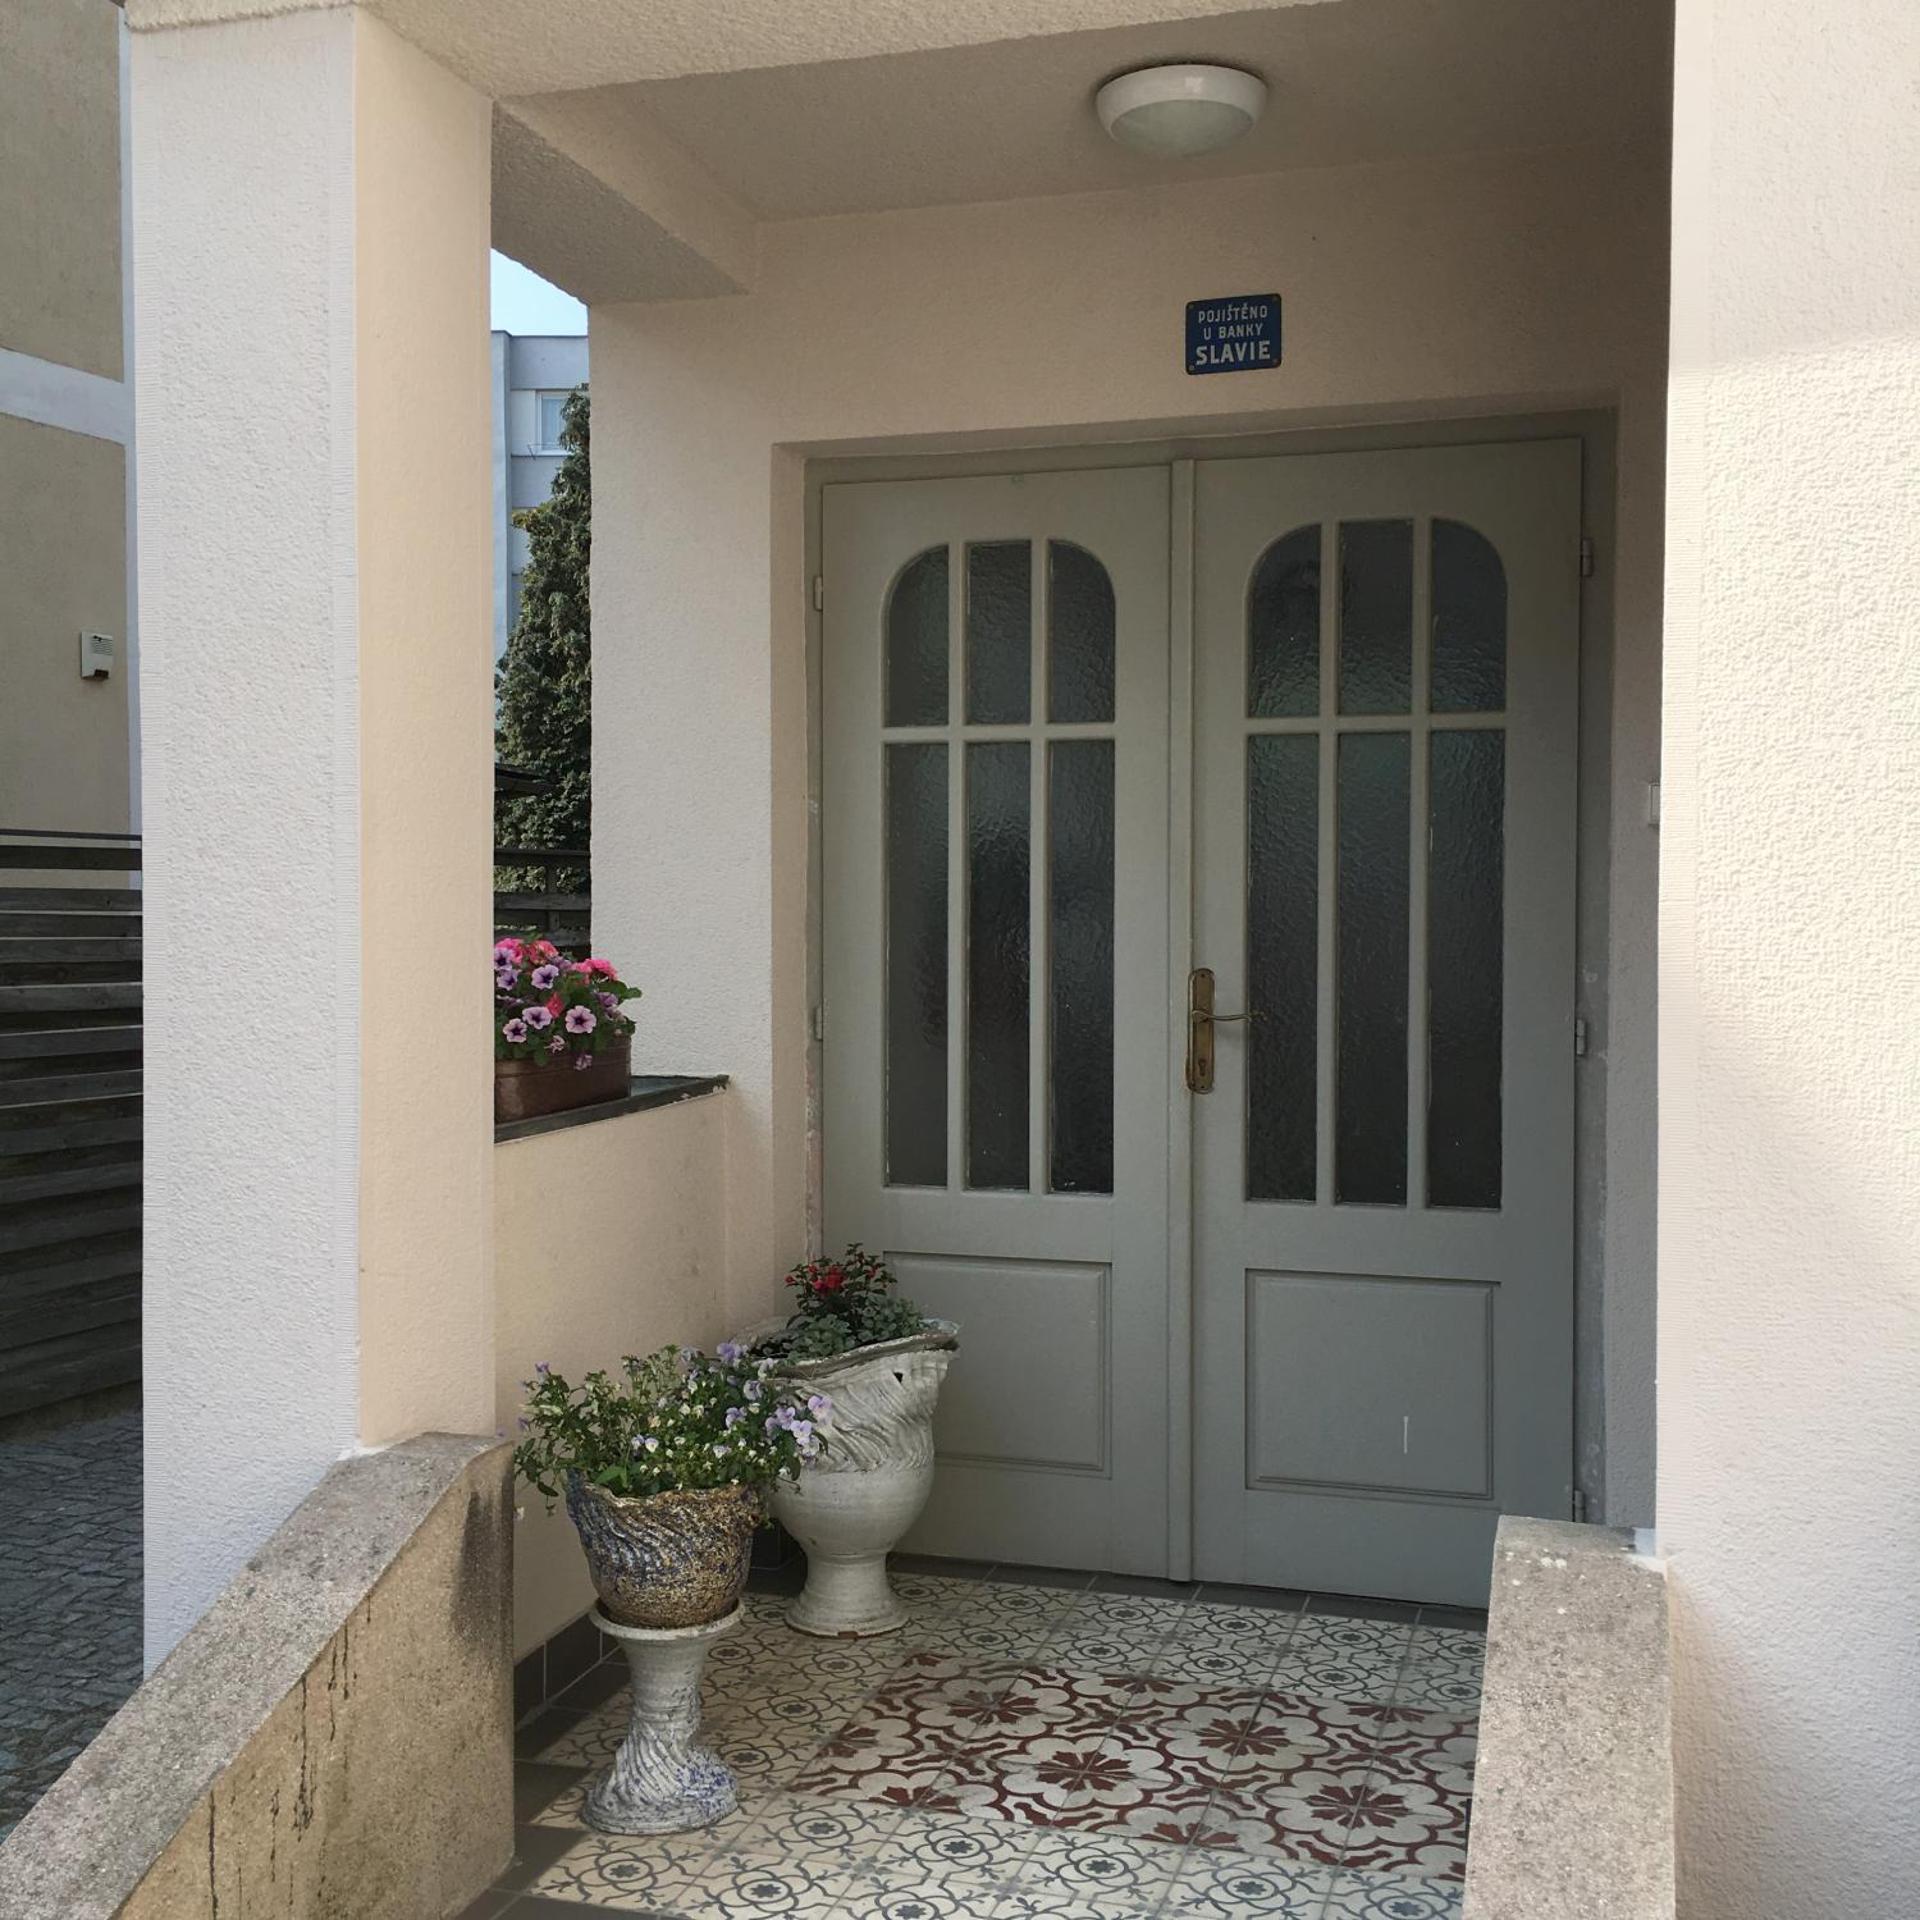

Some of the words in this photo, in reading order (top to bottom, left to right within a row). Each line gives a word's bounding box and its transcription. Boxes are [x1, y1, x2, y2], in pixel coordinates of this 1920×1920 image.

[1198, 302, 1268, 324] POJIŠTĚNO
[1203, 327, 1212, 340] U
[1218, 323, 1263, 339] BANKY
[1195, 340, 1270, 365] SLAVIE
